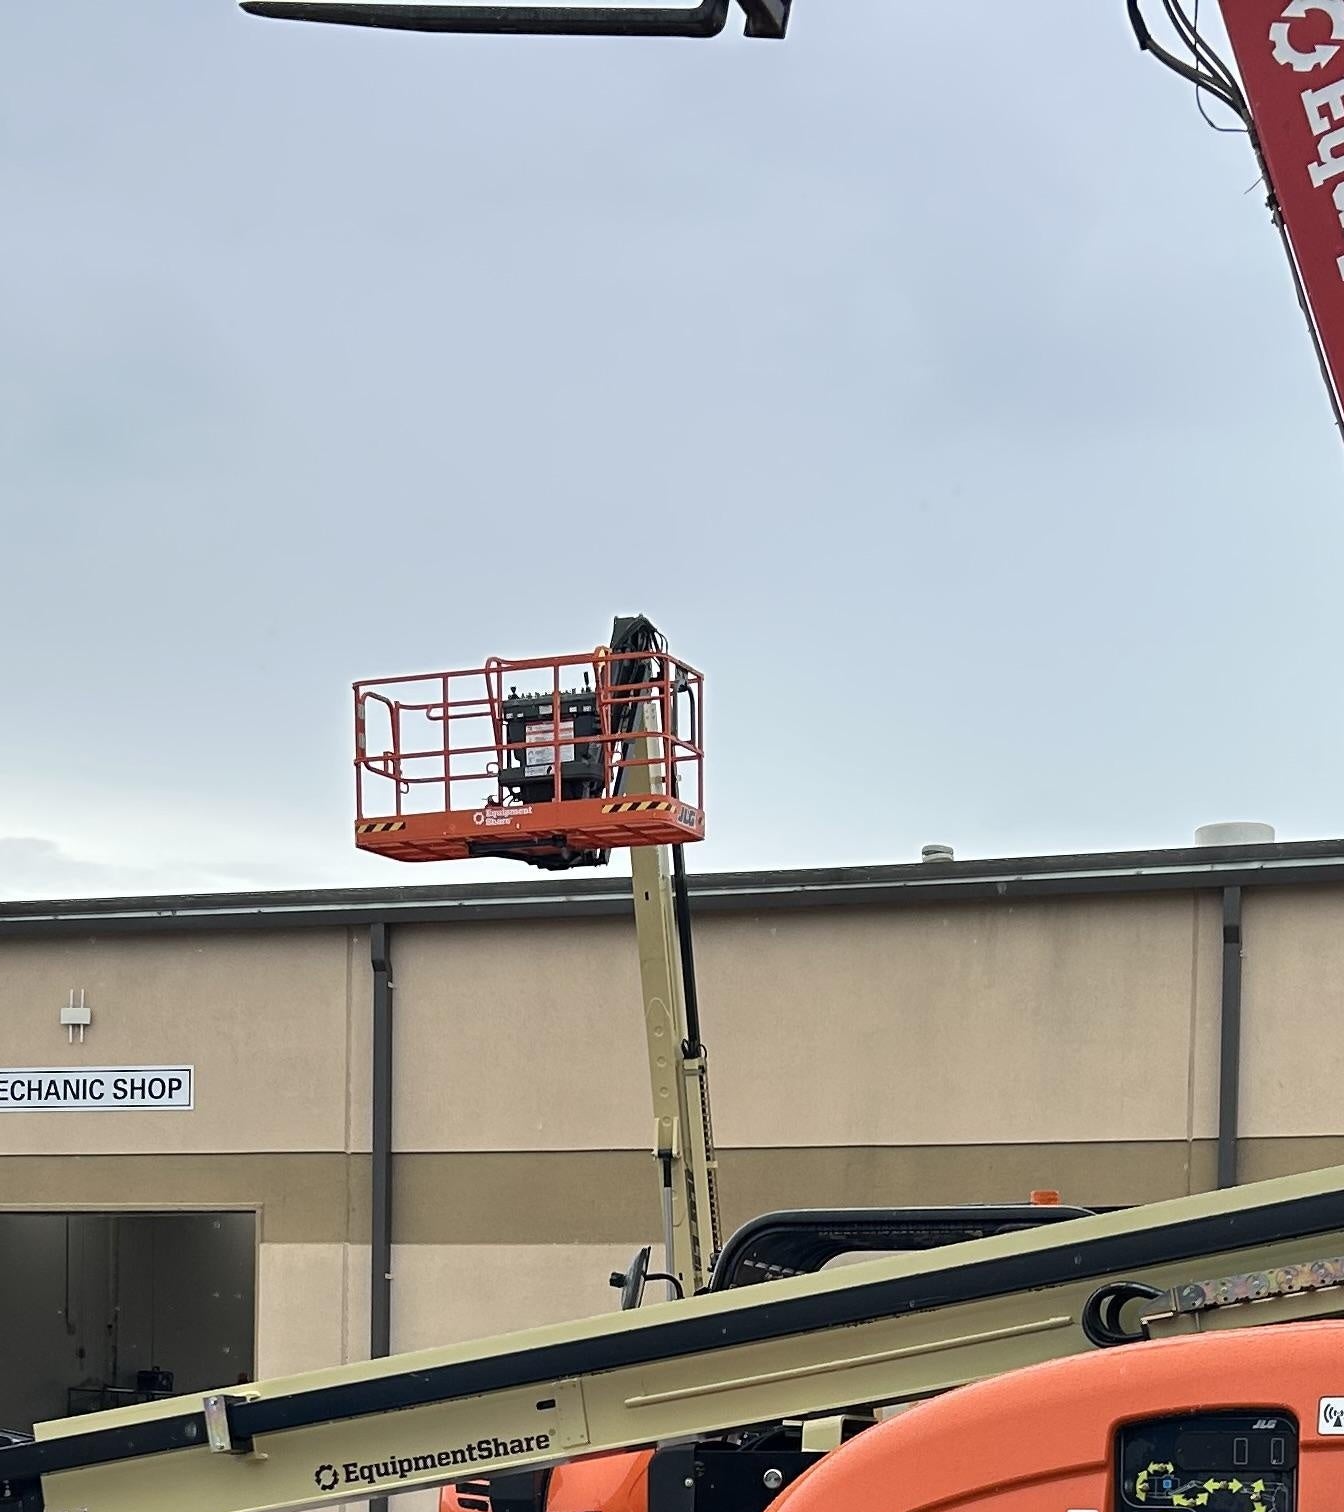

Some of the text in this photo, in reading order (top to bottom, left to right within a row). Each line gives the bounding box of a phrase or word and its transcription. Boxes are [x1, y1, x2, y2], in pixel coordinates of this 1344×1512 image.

[111, 1077, 183, 1101] SHOP
[1252, 1419, 1278, 1430] JLG
[343, 1433, 550, 1485] EquipmentShare
